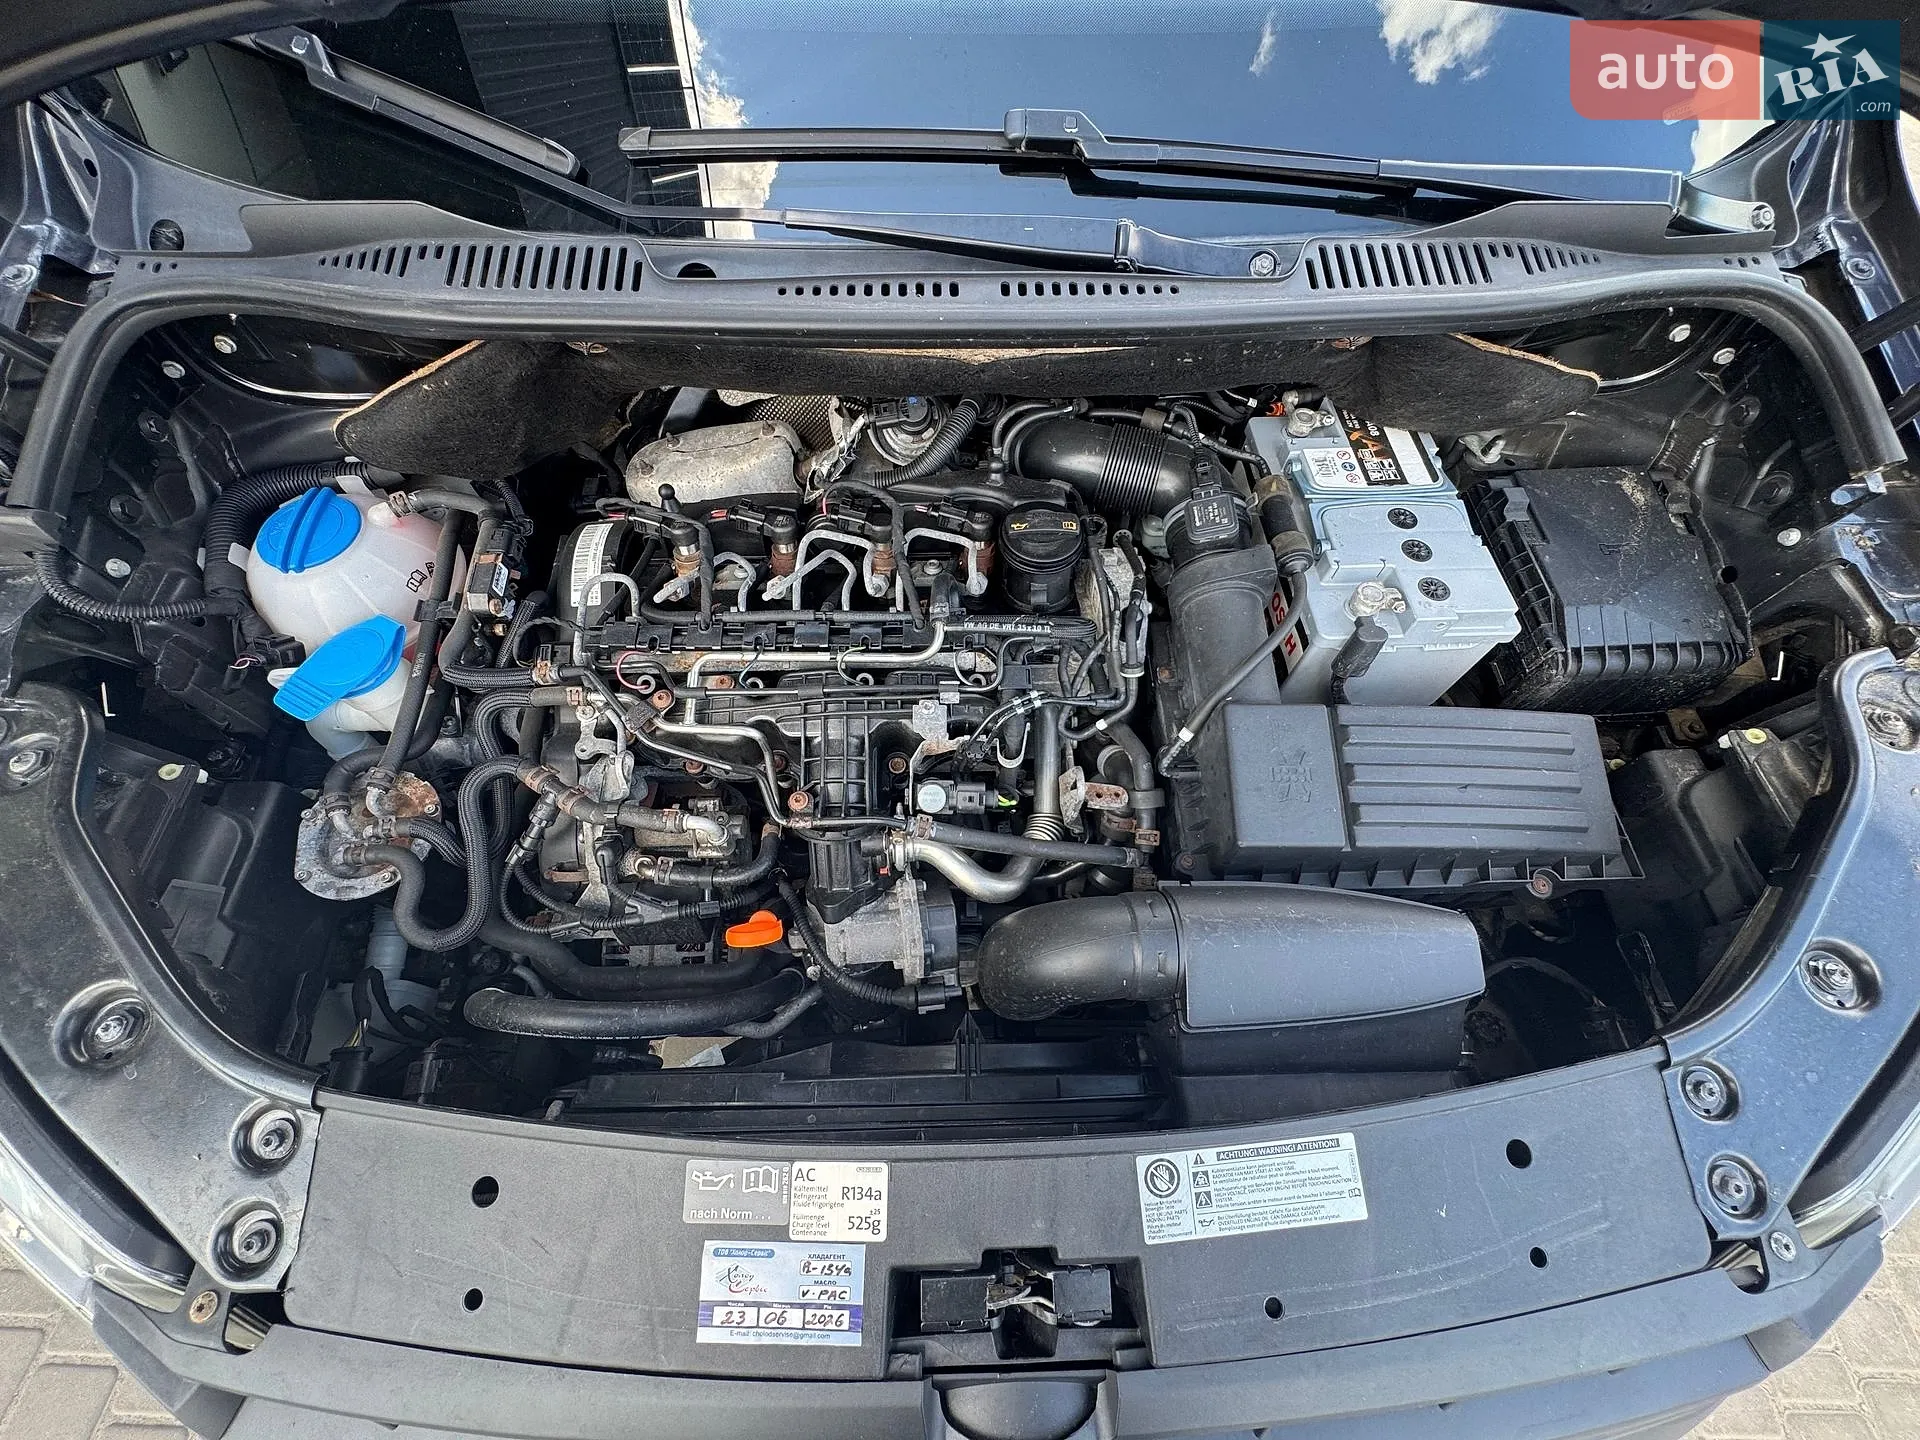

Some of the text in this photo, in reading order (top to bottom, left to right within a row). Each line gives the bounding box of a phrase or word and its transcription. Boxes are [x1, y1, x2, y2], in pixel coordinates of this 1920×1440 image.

[1271, 592, 1297, 656] OSH
[1219, 1139, 1336, 1159] ACHTUNG! WARNING! ATTENTION!
[795, 1168, 815, 1181] AC
[842, 1186, 882, 1201] R134a
[690, 1208, 718, 1219] nach
[721, 1208, 753, 1220] Norm
[848, 1216, 881, 1235] 525g
[720, 1310, 845, 1327] 23 06 2026
